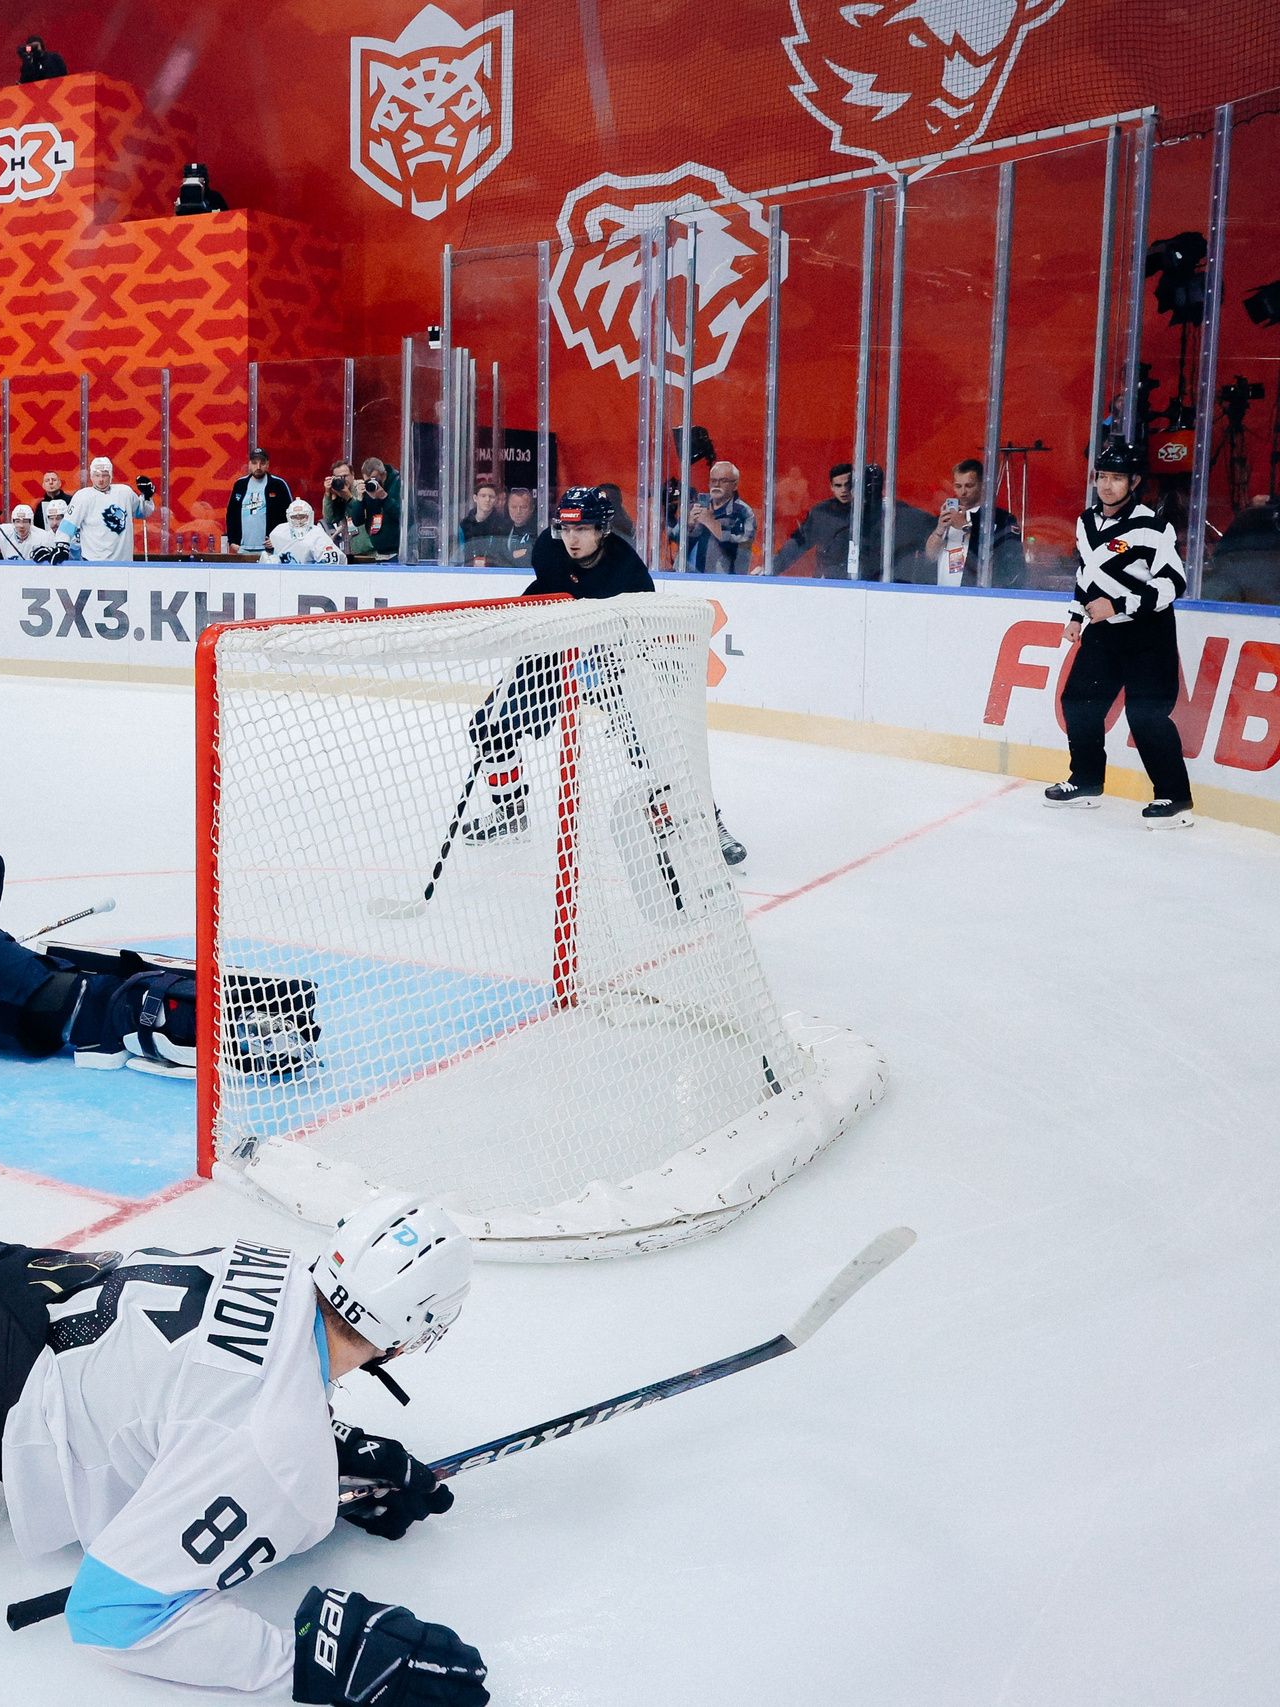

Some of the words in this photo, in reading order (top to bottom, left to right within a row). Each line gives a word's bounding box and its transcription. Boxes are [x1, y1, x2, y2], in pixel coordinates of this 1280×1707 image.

[323, 551, 339, 564] 39
[19, 588, 389, 642] 3X3.KH
[329, 1284, 366, 1325] 86
[181, 1496, 277, 1590] 86
